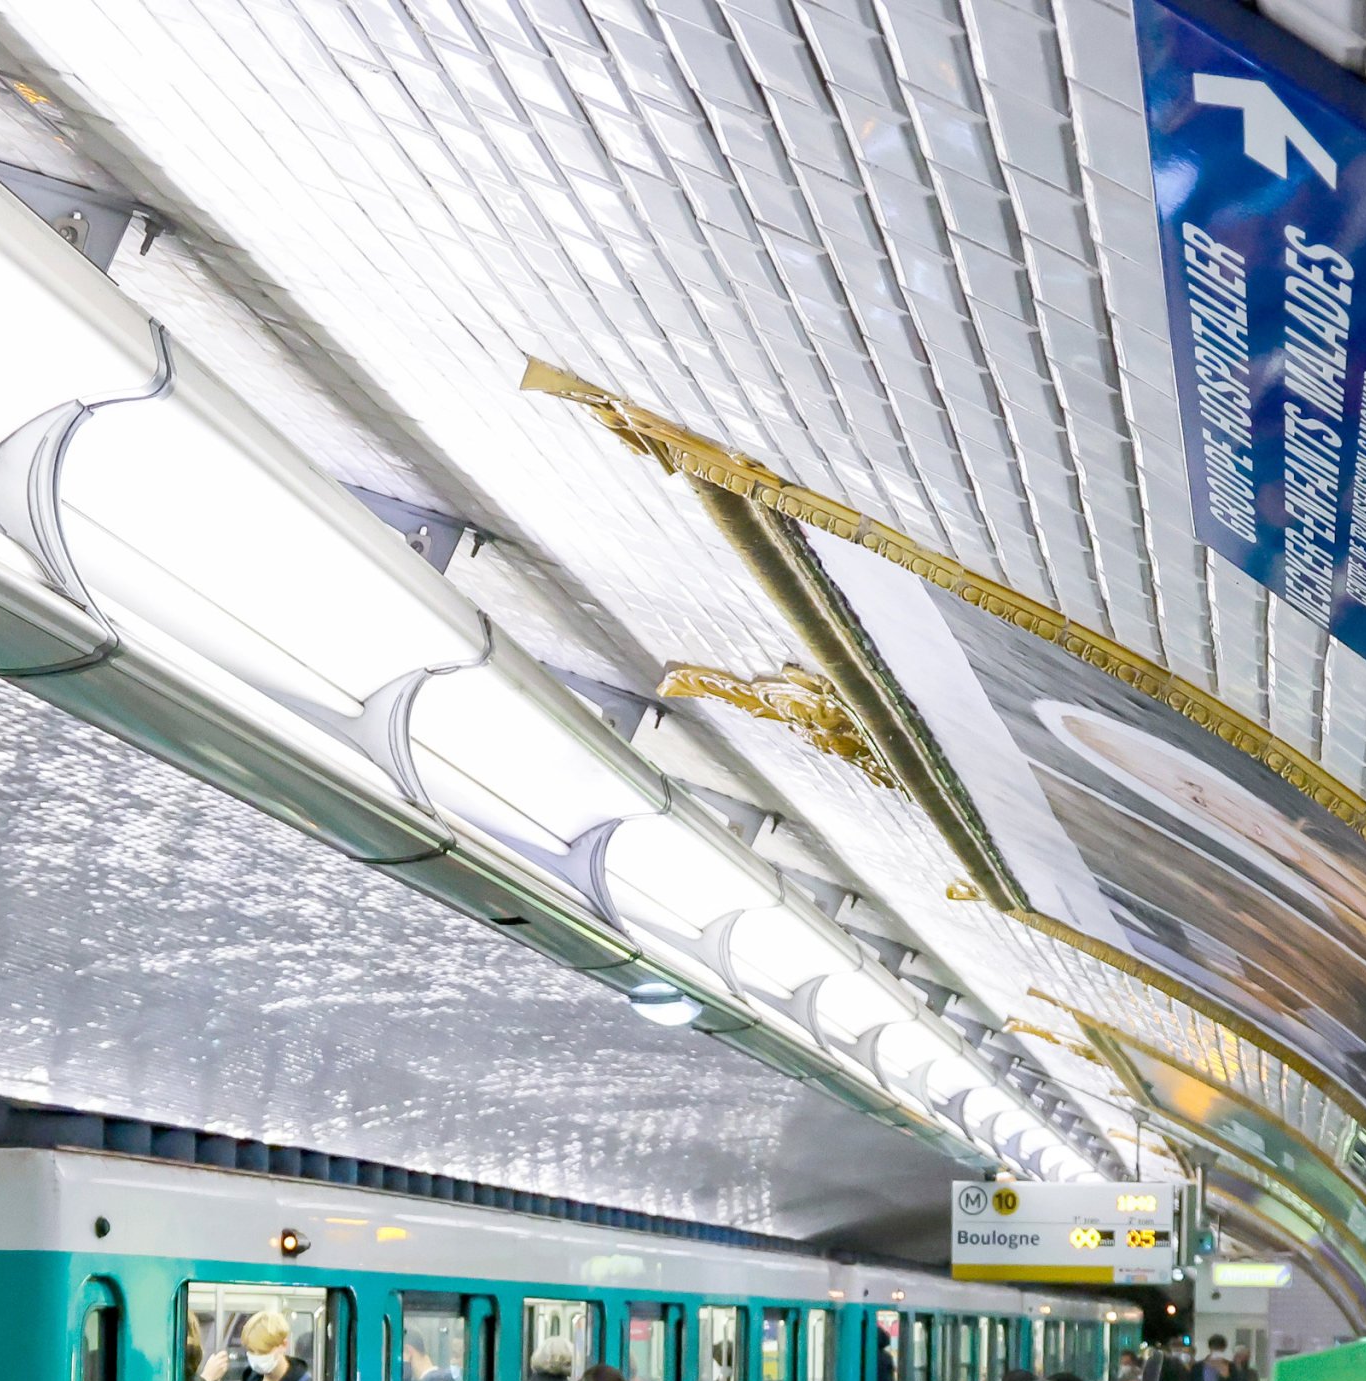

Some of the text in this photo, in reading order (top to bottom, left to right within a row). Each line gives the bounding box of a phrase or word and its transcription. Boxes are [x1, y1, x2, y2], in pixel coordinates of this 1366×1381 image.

[1182, 221, 1257, 543] GROUPE HOSPITALIER
[1284, 224, 1355, 629] NECKER-ENFANTS MALADES
[966, 1192, 1017, 1209] M 10
[957, 1230, 1040, 1249] Boulogne
[1069, 1227, 1115, 1249] 00 min
[1126, 1229, 1171, 1248] 05 min
